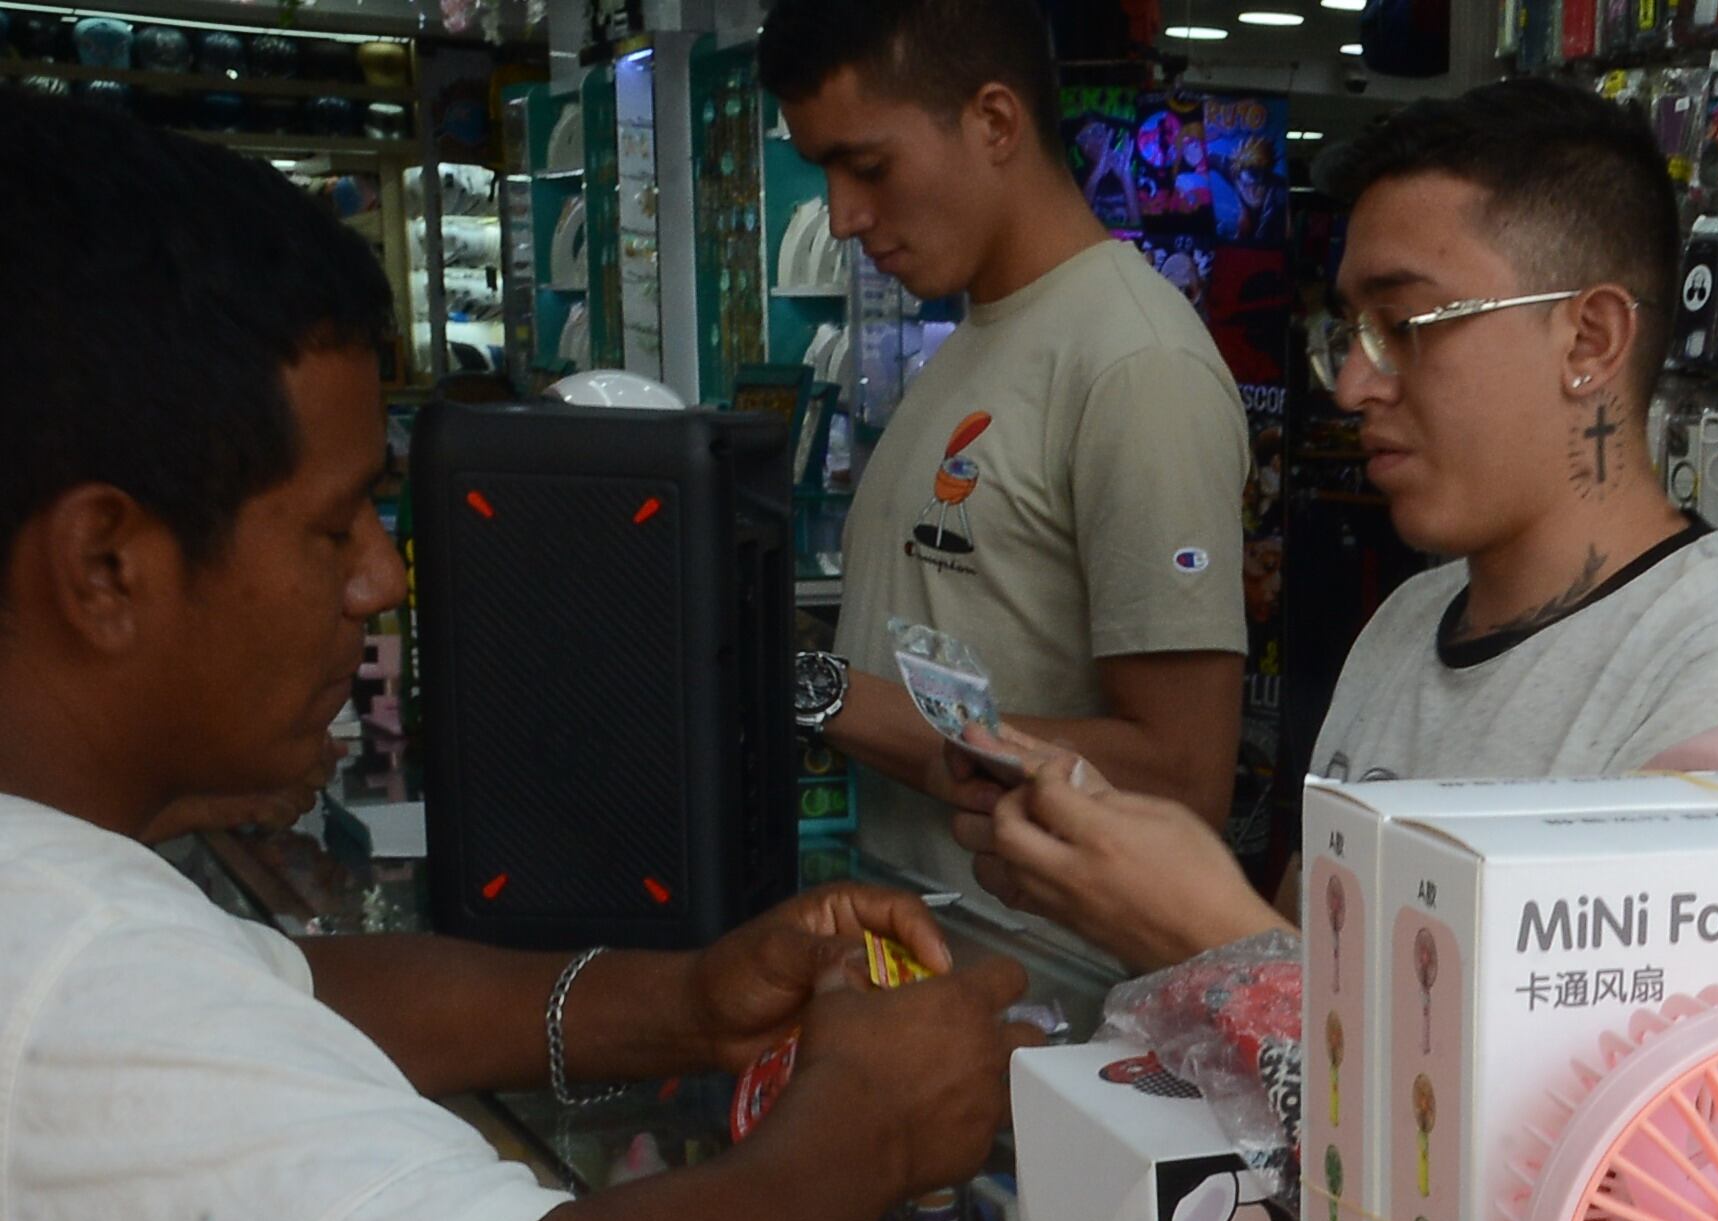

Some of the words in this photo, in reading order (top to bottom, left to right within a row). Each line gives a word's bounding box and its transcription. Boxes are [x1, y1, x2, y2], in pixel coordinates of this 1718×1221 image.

[1516, 892, 1649, 953] MiNi
[1515, 965, 1664, 1012] 卡通风扇
